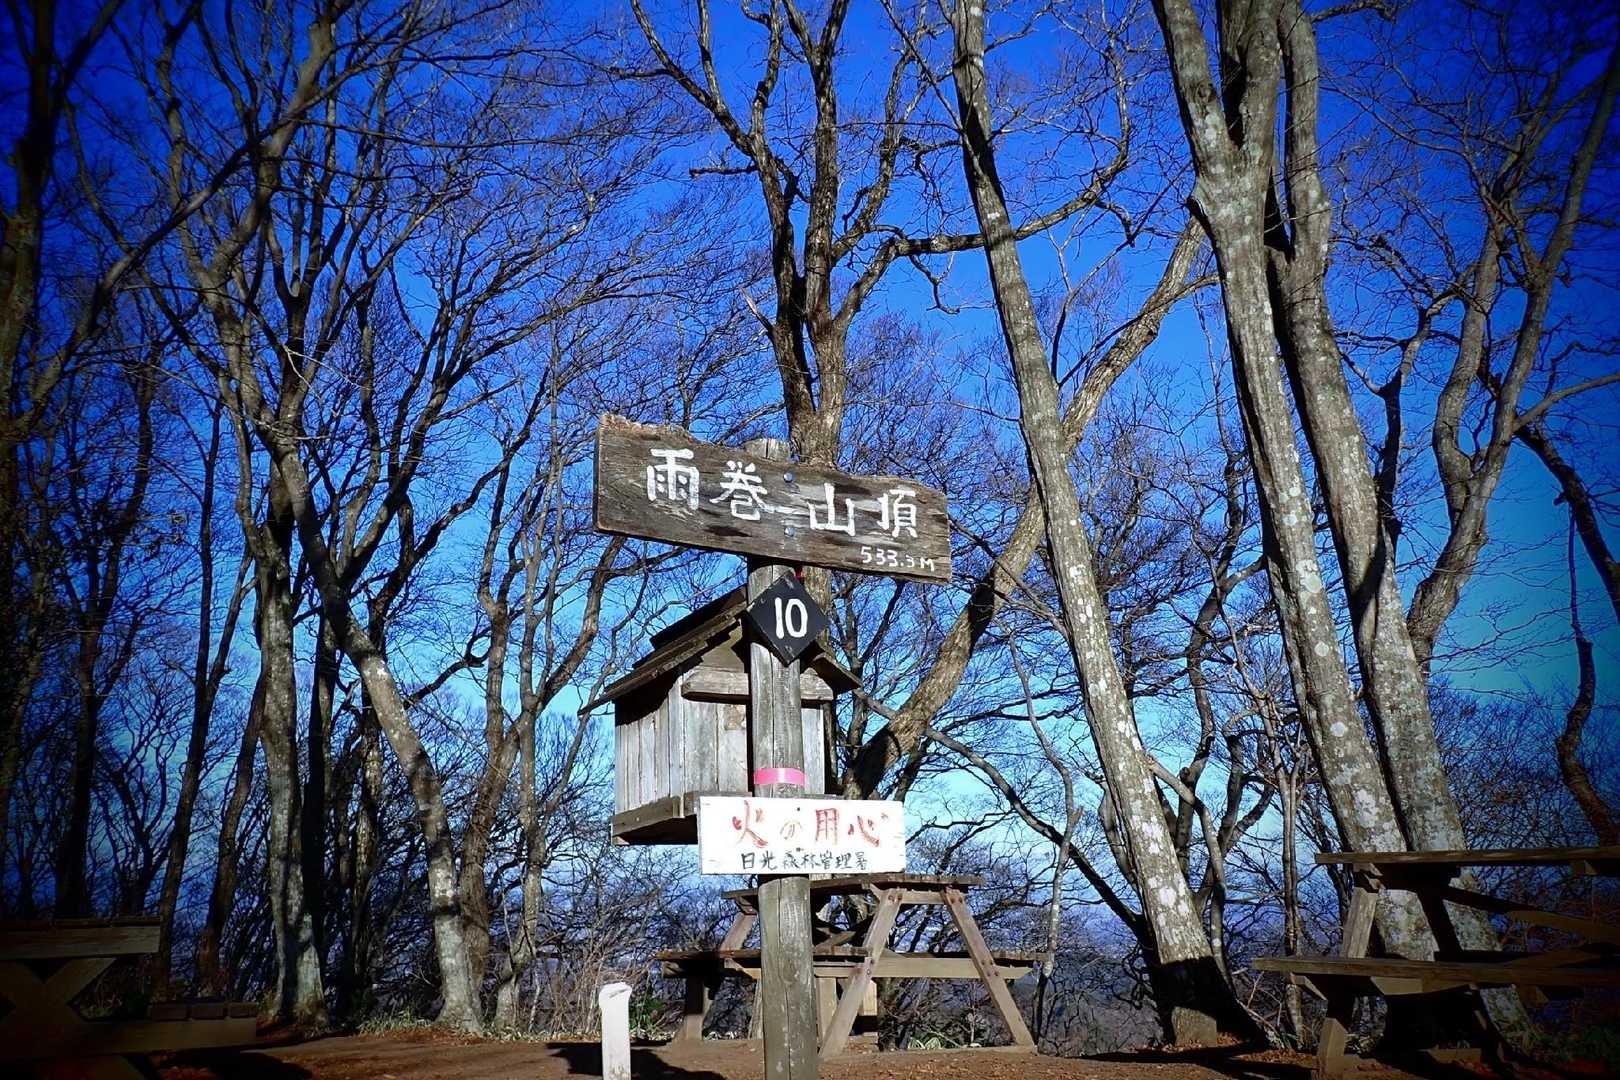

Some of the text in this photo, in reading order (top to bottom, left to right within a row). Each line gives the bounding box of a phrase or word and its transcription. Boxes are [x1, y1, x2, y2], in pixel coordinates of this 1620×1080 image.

[646, 448, 918, 538] 雨巻山頂
[774, 597, 808, 639] 10
[732, 799, 889, 849] 火の用心
